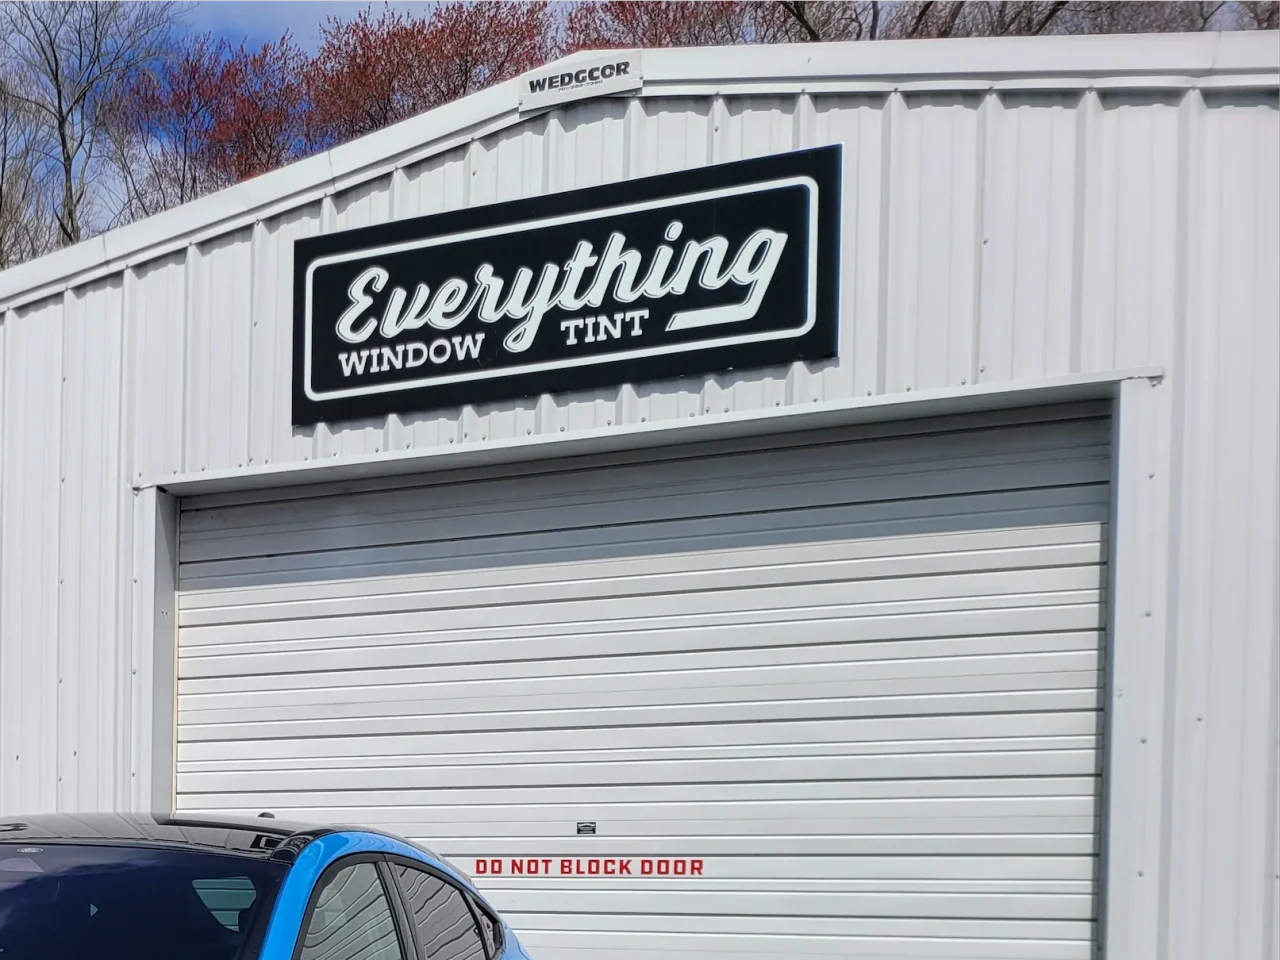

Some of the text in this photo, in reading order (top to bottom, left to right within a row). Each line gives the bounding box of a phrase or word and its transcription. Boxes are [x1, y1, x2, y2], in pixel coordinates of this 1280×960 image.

[529, 61, 631, 94] WEDGCOR
[335, 221, 788, 353] Everything
[338, 309, 650, 377] WINDOW TINT
[475, 859, 704, 875] DO NOT BLOCK DOOR
